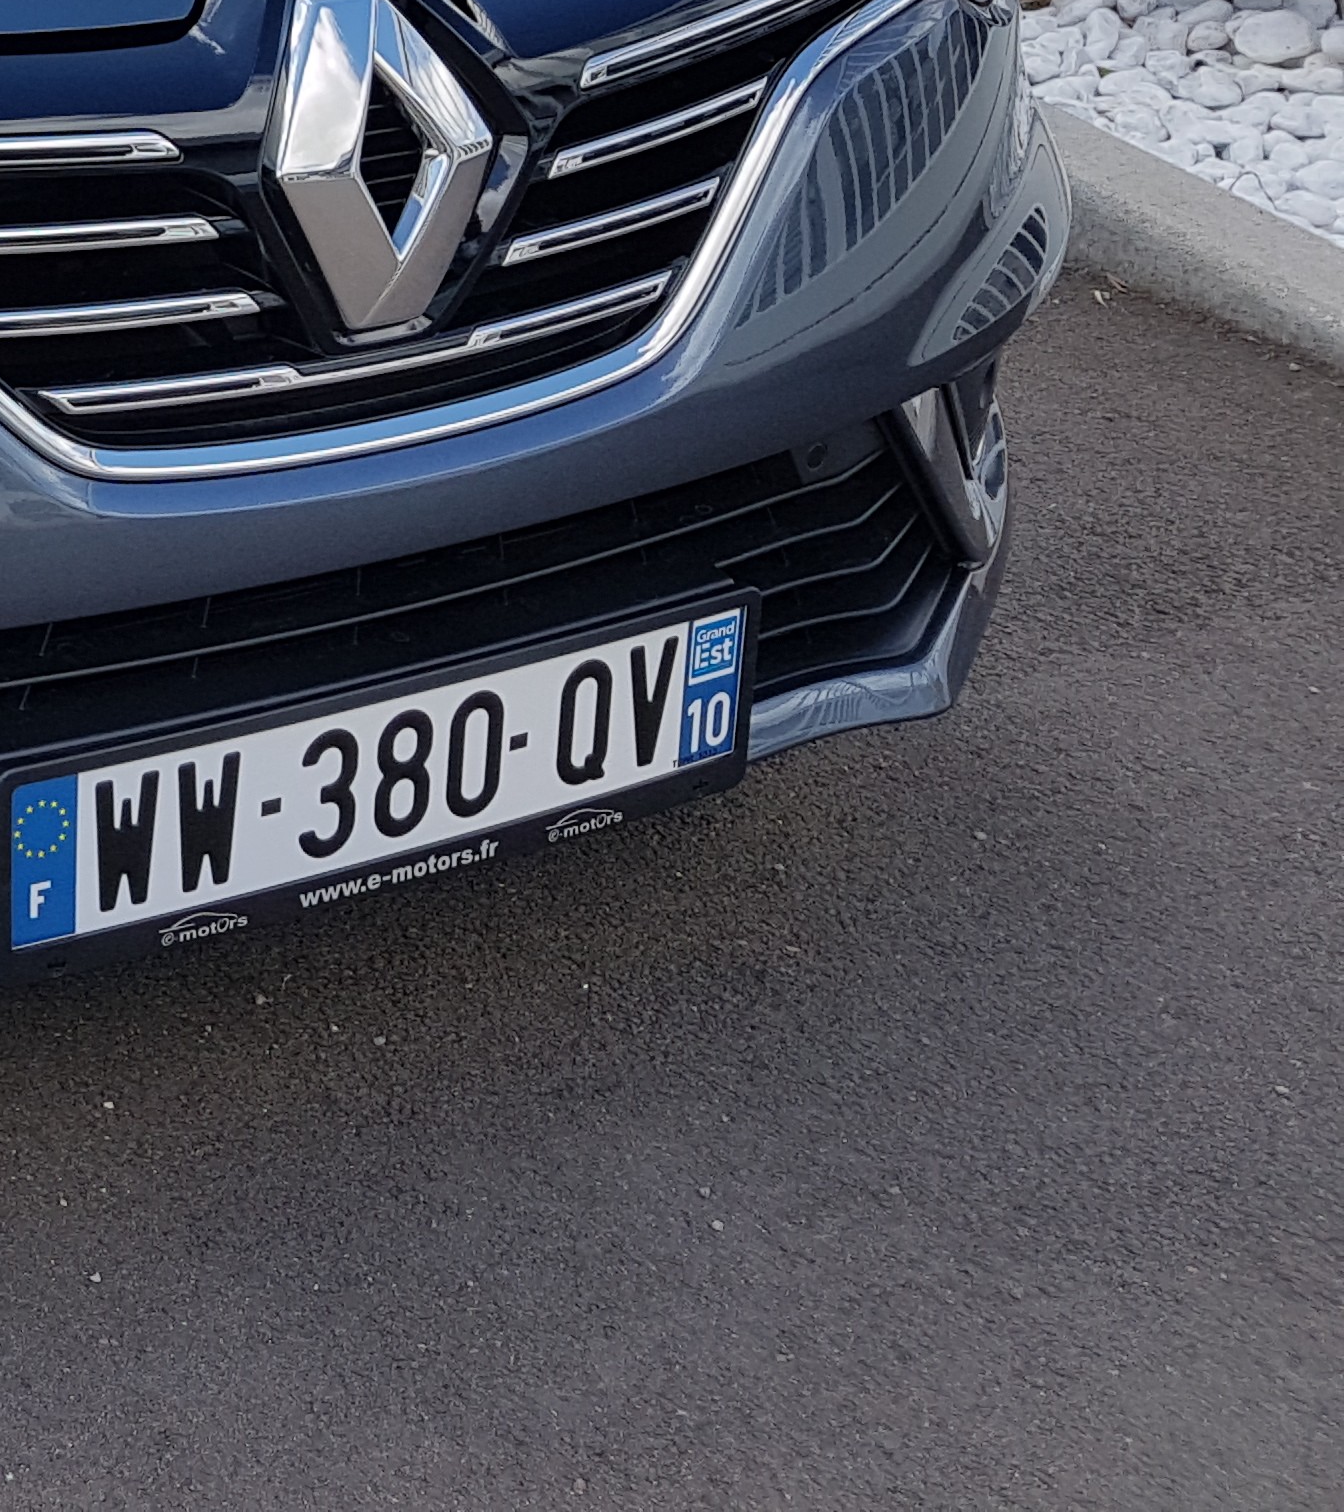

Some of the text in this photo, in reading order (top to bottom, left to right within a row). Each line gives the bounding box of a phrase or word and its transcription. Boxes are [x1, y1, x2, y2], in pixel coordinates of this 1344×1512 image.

[696, 621, 736, 643] Grand
[694, 637, 733, 670] Est
[687, 691, 731, 753] 10
[299, 839, 499, 909] www.e-motors.fr
[29, 879, 52, 919] F
